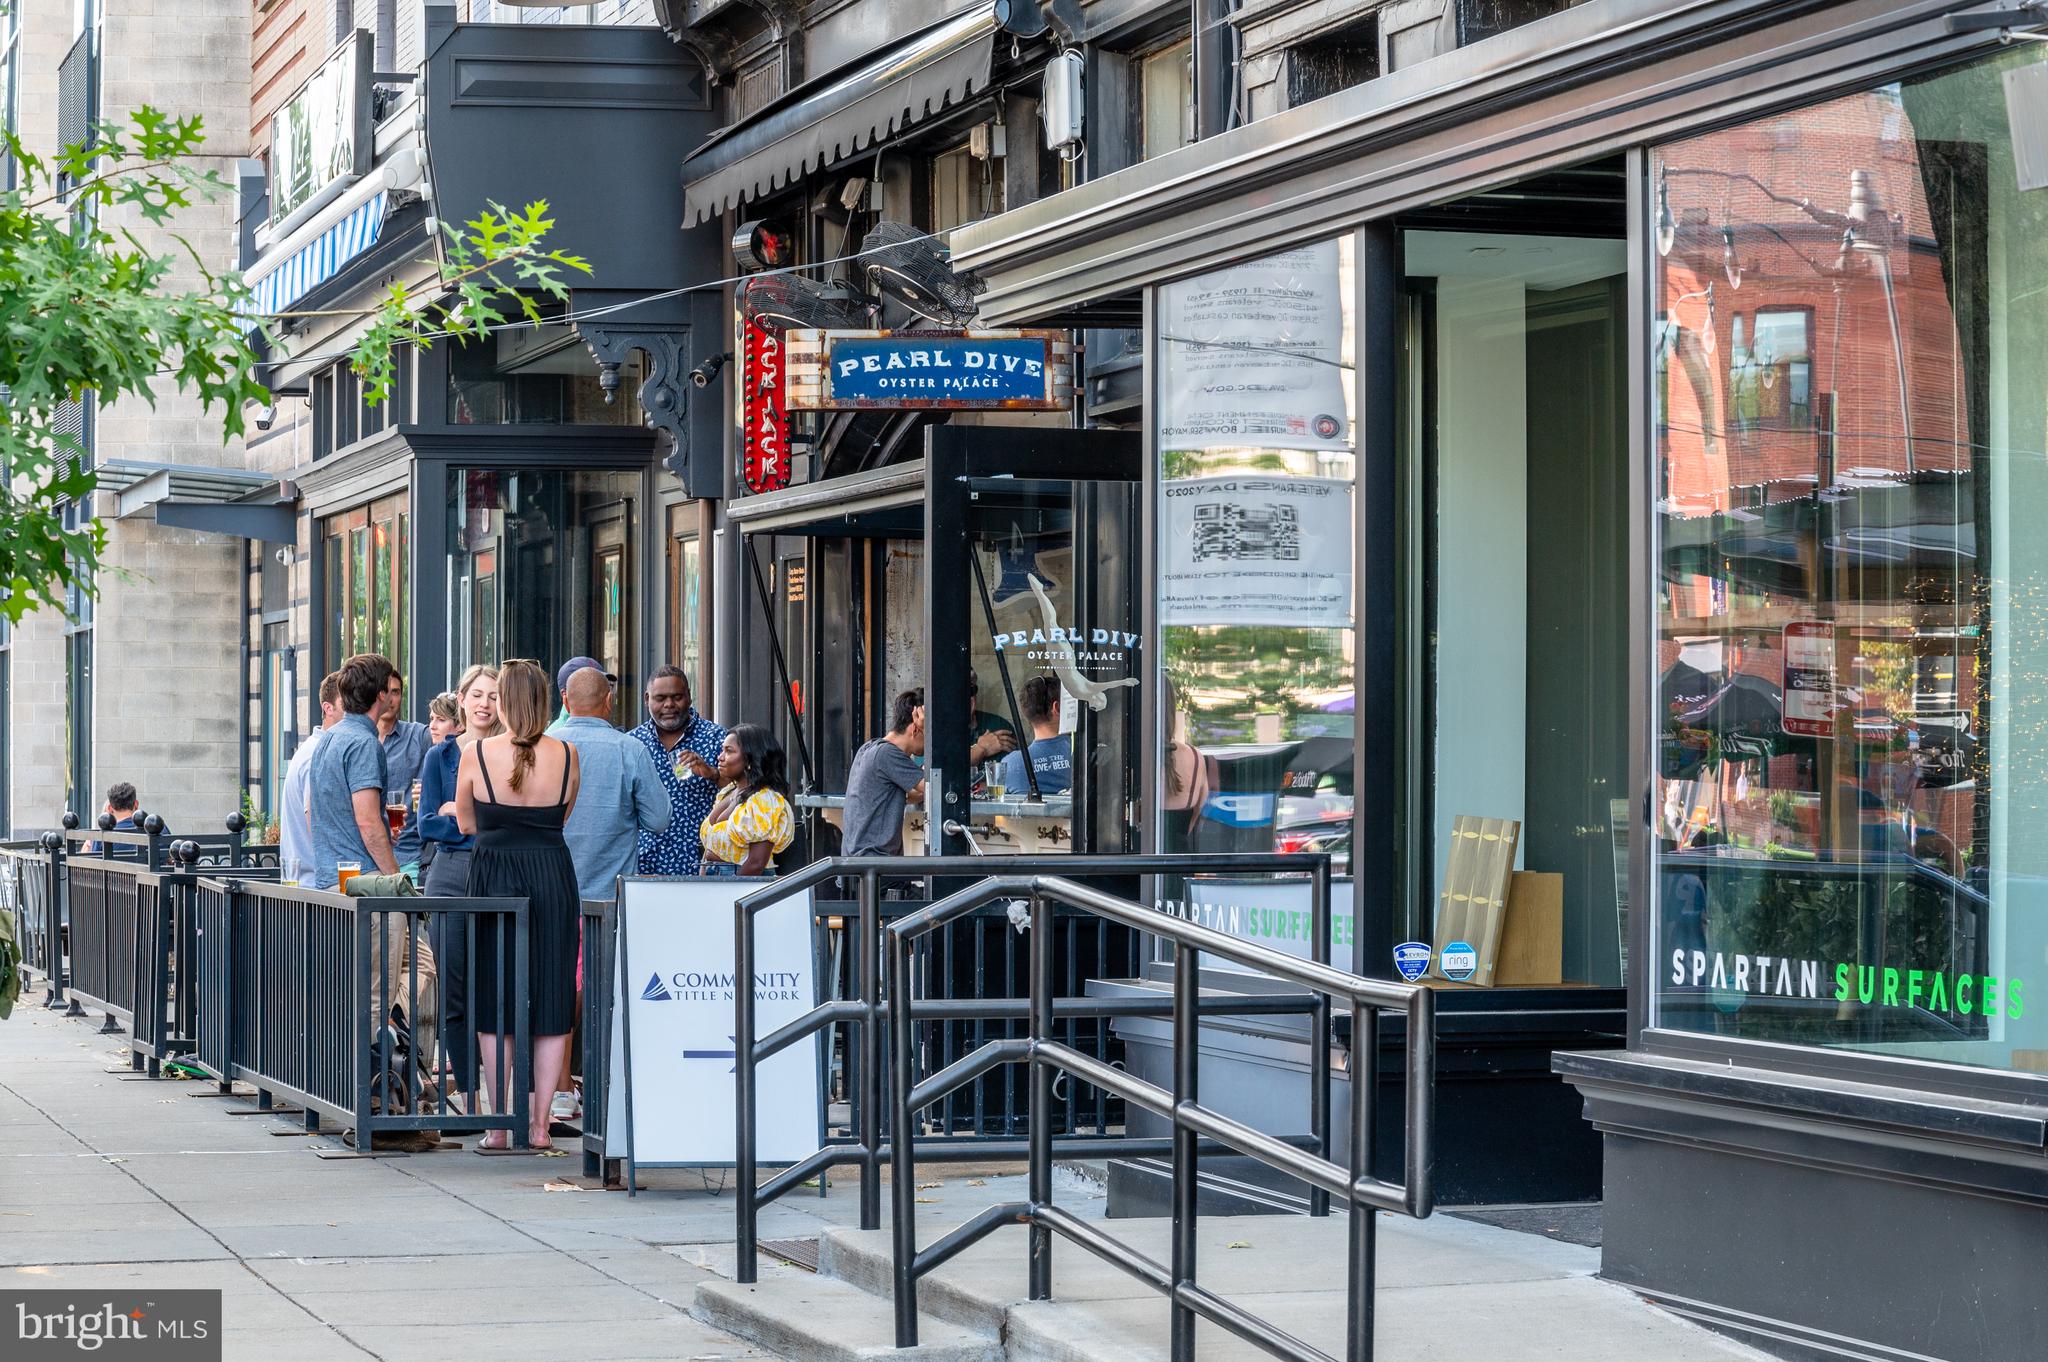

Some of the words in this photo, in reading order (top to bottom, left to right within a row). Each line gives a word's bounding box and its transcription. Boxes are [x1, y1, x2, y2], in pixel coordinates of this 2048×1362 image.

[838, 349, 952, 377] PEARL
[964, 351, 1042, 378] DIVE
[879, 378, 936, 388] OYSTER
[944, 377, 999, 388] PALACE
[760, 397, 779, 478] JACK
[993, 627, 1083, 651] PEARL
[1093, 628, 1142, 650] DIV
[1027, 651, 1073, 660] OYSTER
[1079, 652, 1123, 661] PALACE
[1034, 763, 1048, 773] OVE
[1052, 760, 1070, 770] BEER
[1249, 907, 1354, 945] SURFAES
[1448, 955, 1469, 967] ring
[672, 973, 800, 988] COMMNITY
[1672, 948, 1818, 998] SPARTAN
[1835, 963, 2024, 1020] SURFACES
[675, 991, 716, 1001] TITLE
[724, 991, 800, 1001] NWORK
